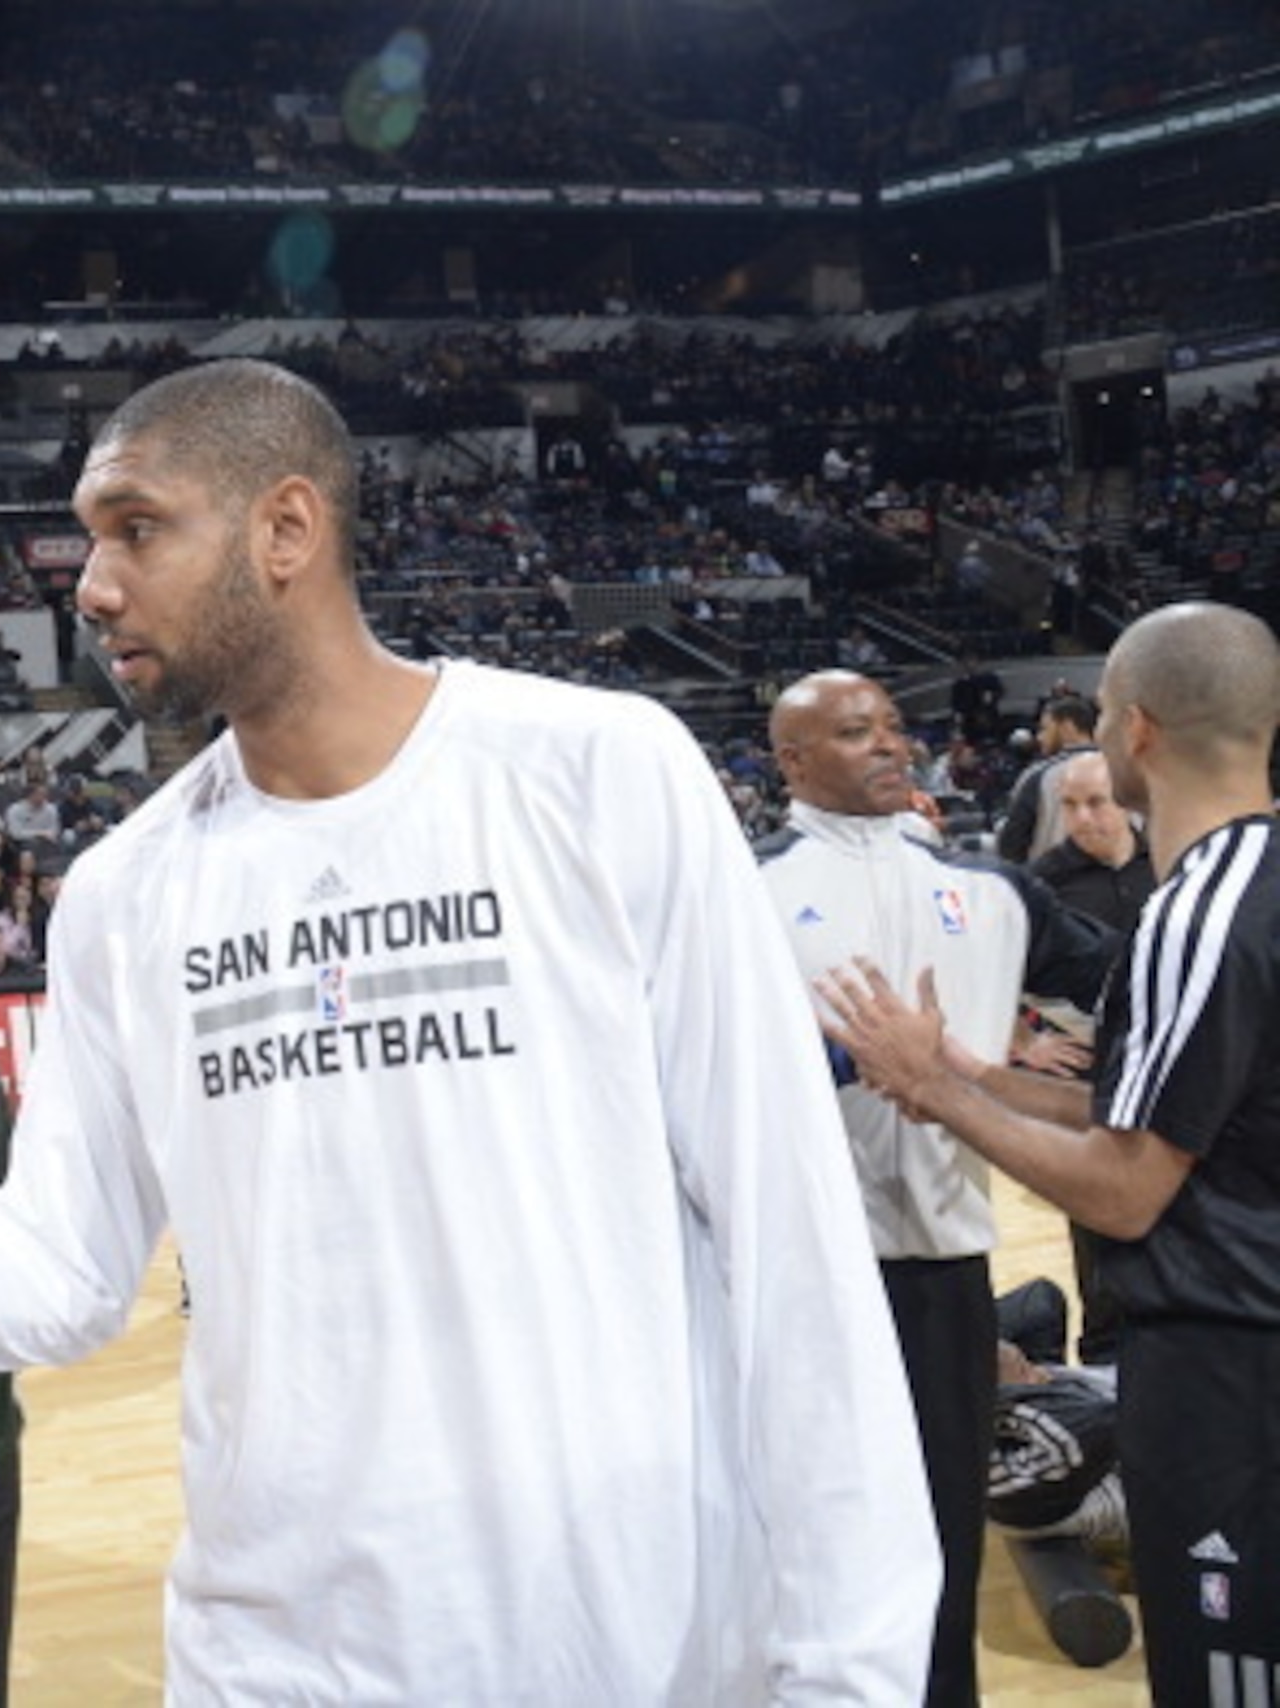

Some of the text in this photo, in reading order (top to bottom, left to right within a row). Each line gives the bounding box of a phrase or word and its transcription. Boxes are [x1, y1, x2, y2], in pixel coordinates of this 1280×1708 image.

[184, 889, 502, 994] SAN ANTONIO
[198, 1007, 516, 1099] BASKETBALL
